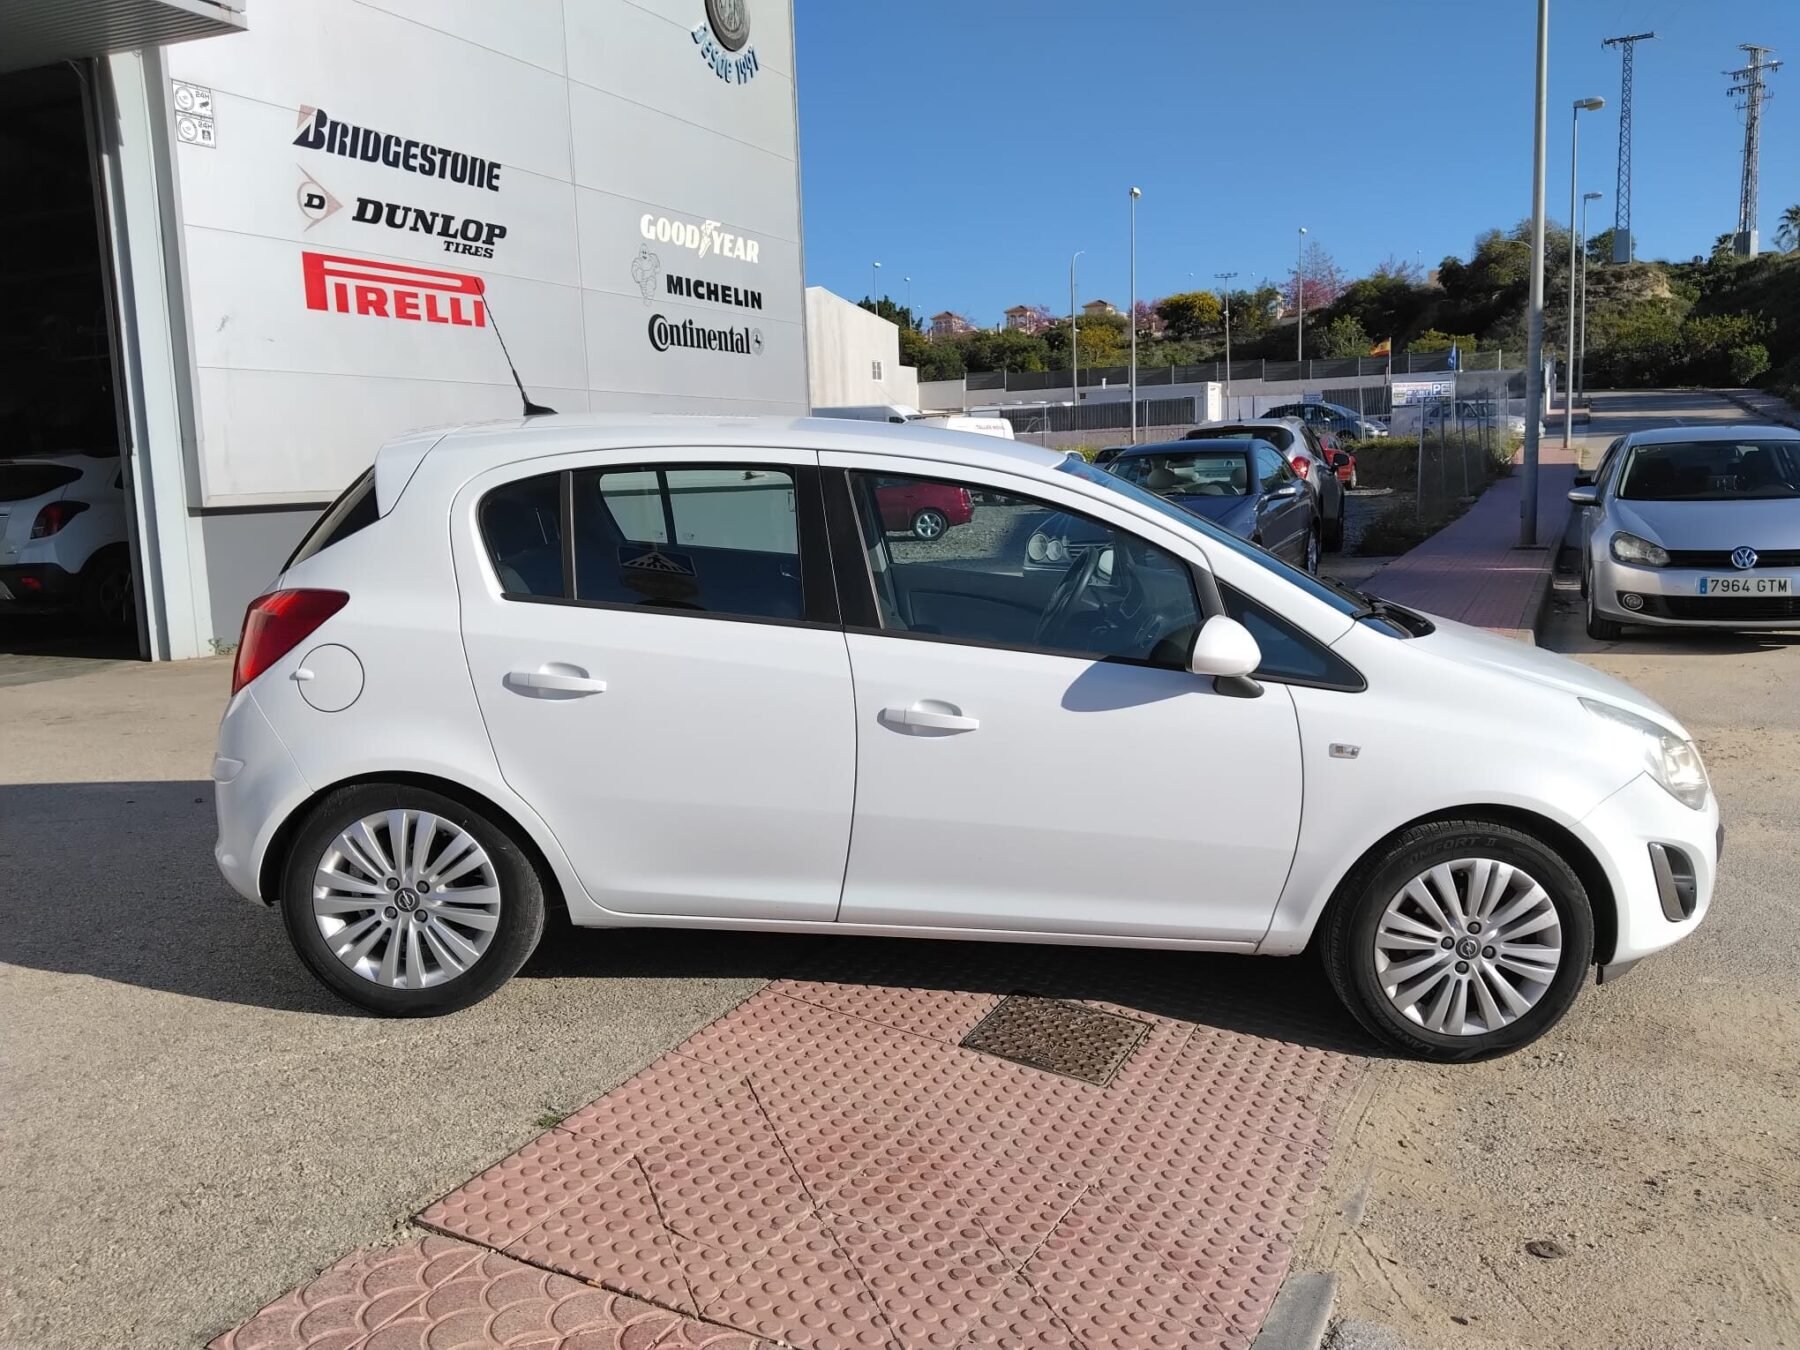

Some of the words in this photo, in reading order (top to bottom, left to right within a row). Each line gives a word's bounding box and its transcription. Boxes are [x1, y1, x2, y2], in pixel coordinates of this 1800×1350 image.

[292, 105, 502, 192] BRIDGESTONE
[352, 196, 507, 246] DUNLOP
[443, 240, 494, 259] TIRES
[302, 251, 485, 328] PIRELLI
[666, 273, 762, 310] MICHELIN
[648, 313, 751, 355] Continental
[1710, 579, 1750, 592] 7964
[1757, 579, 1787, 592] GTM
